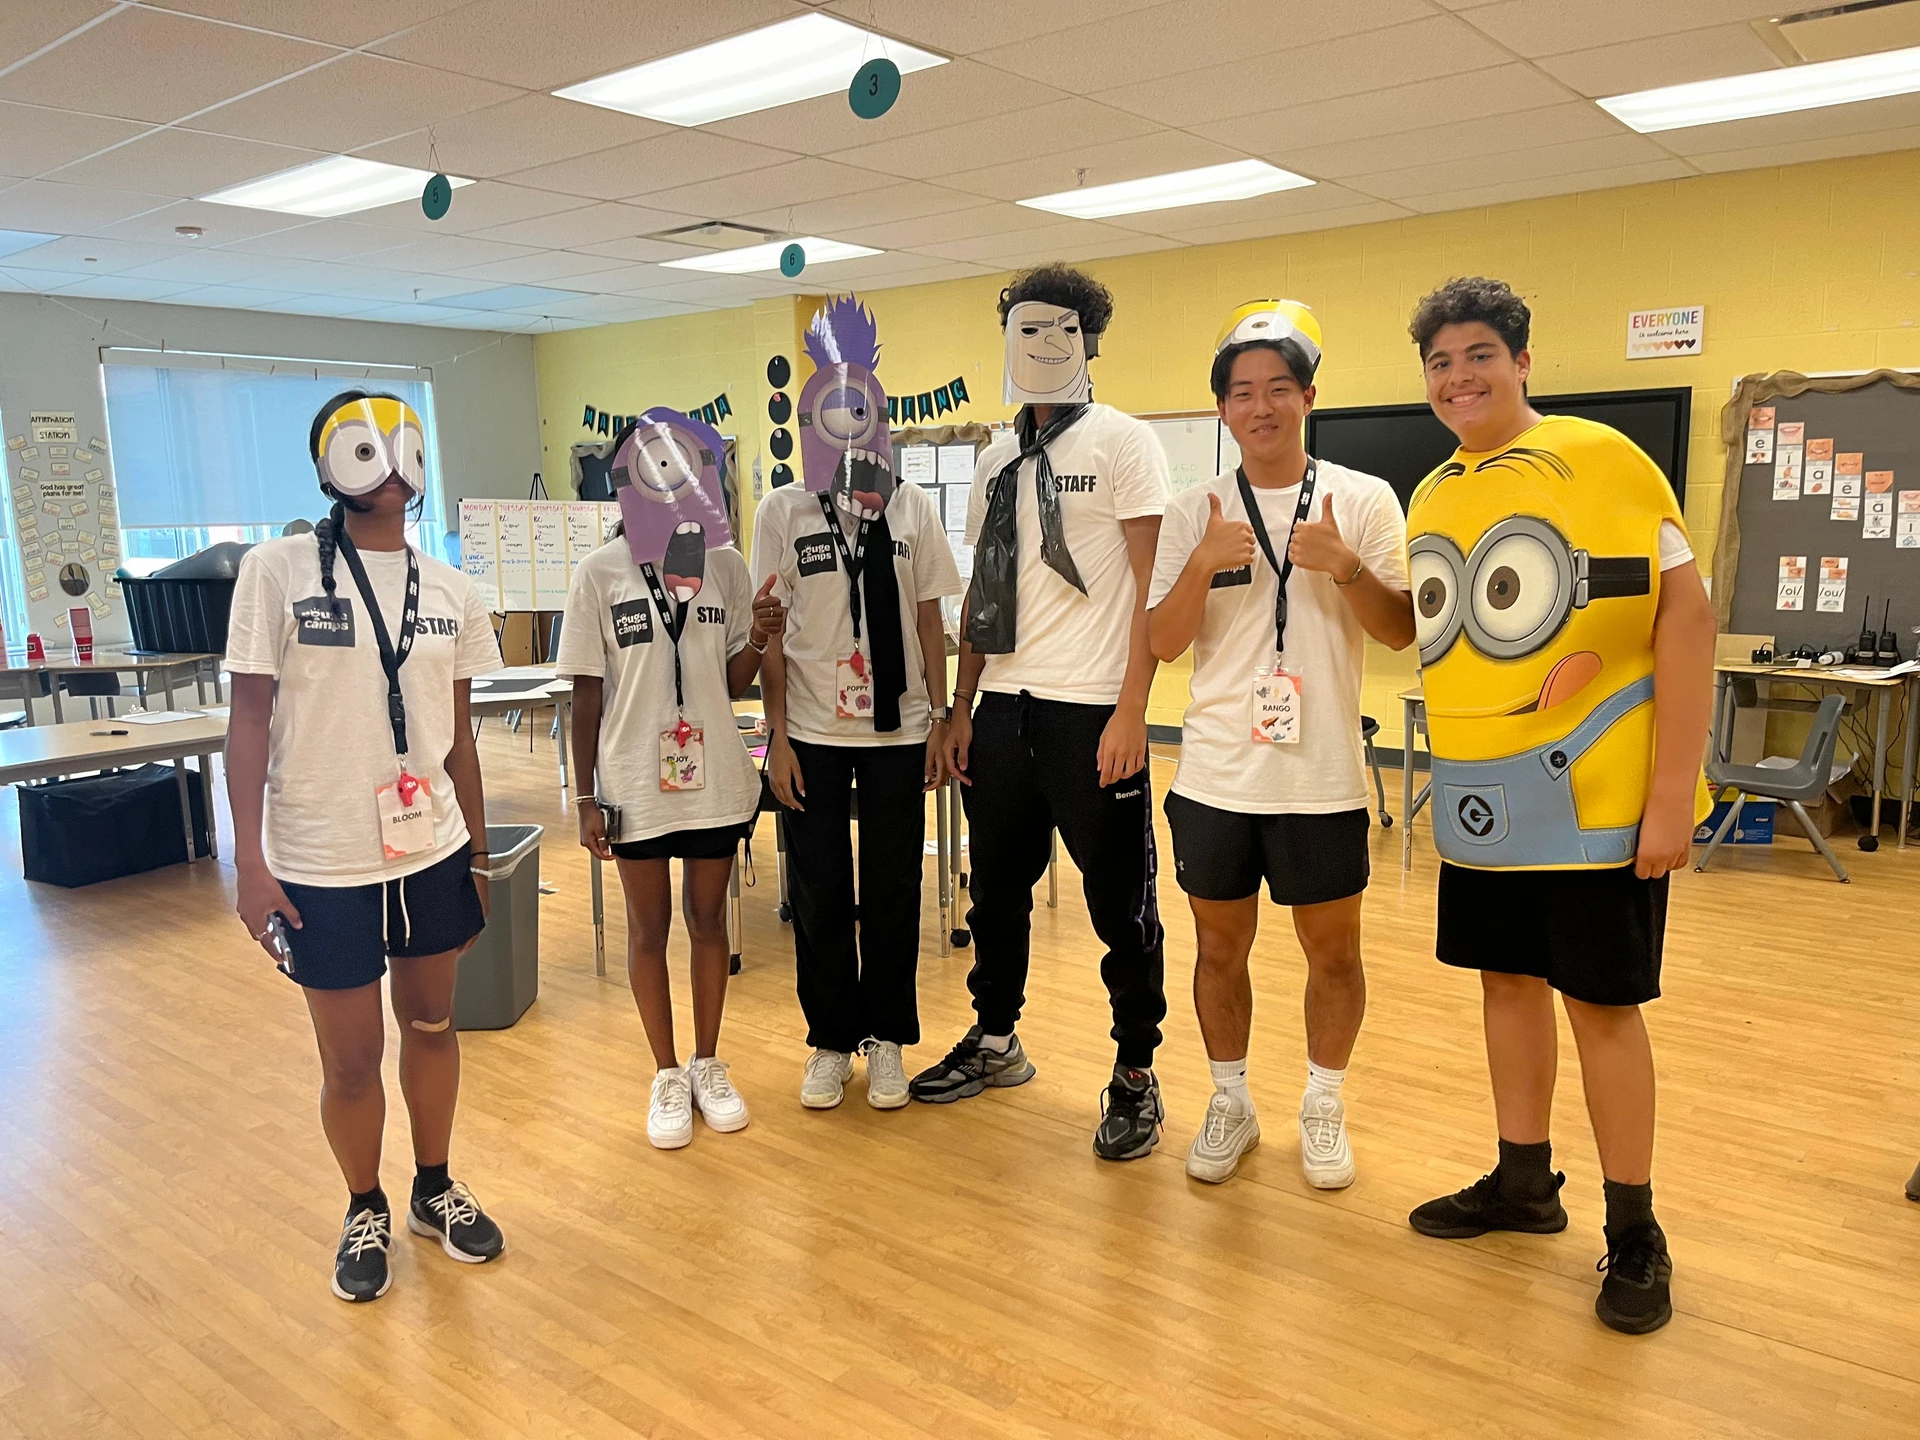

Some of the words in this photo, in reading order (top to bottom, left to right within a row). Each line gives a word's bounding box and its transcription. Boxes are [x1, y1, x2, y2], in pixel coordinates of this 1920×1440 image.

[869, 73, 878, 96] 3
[432, 186, 439, 204] 5
[789, 252, 795, 266] 6
[1633, 311, 1698, 329] EVERYONE
[30, 416, 75, 424] AFFIRMATION
[39, 431, 71, 440] STATION
[67, 484, 84, 492] great
[1055, 474, 1097, 493] STAFF
[42, 490, 60, 498] plans
[801, 544, 831, 556] rouge
[801, 552, 832, 565] camps
[616, 612, 647, 627] rouge
[304, 620, 349, 633] camps
[618, 622, 648, 635] camps
[1262, 704, 1291, 712] RANGO
[392, 811, 422, 824] BLOOM
